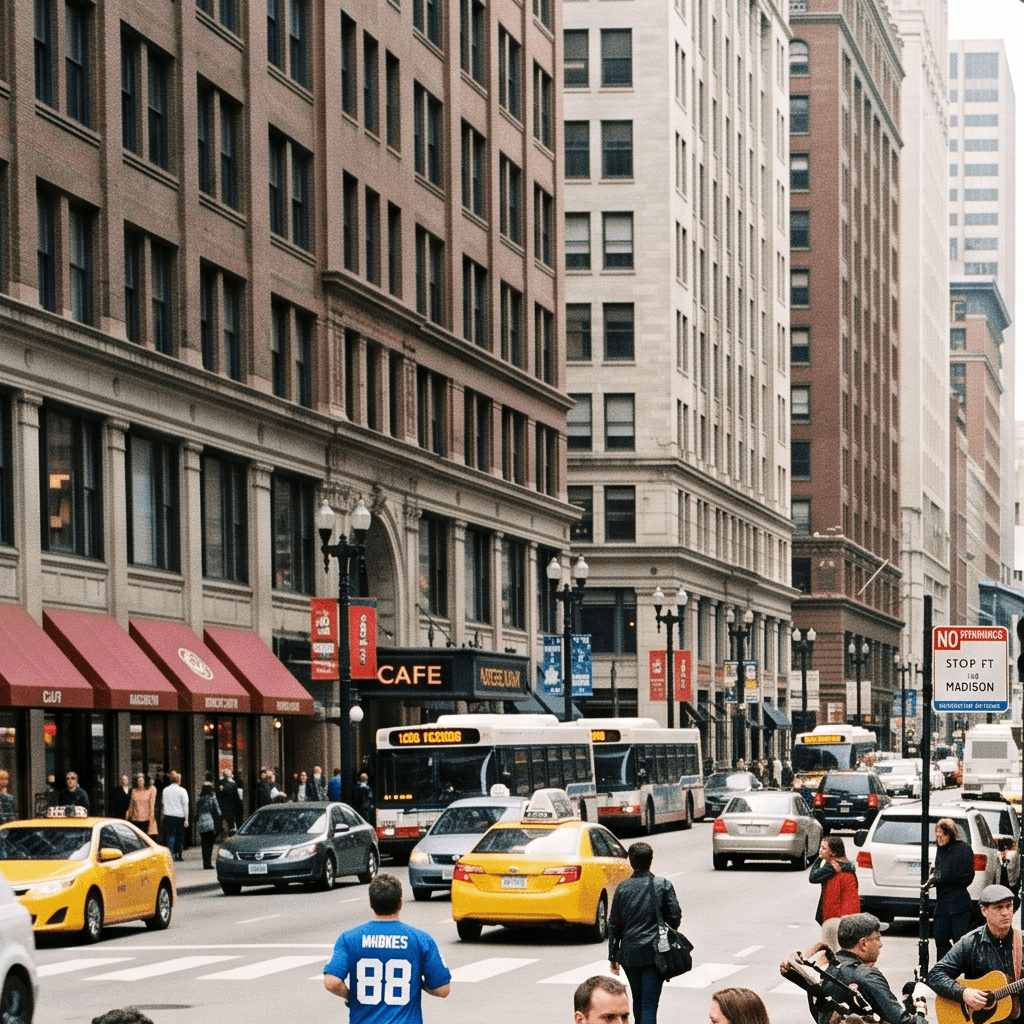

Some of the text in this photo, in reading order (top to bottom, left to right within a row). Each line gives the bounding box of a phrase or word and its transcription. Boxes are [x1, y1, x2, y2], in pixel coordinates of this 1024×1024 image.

[937, 630, 959, 648] NO
[946, 658, 976, 669] STOP
[377, 665, 442, 685] CAFE
[946, 682, 995, 692] MADISON
[356, 957, 412, 1006] 88
